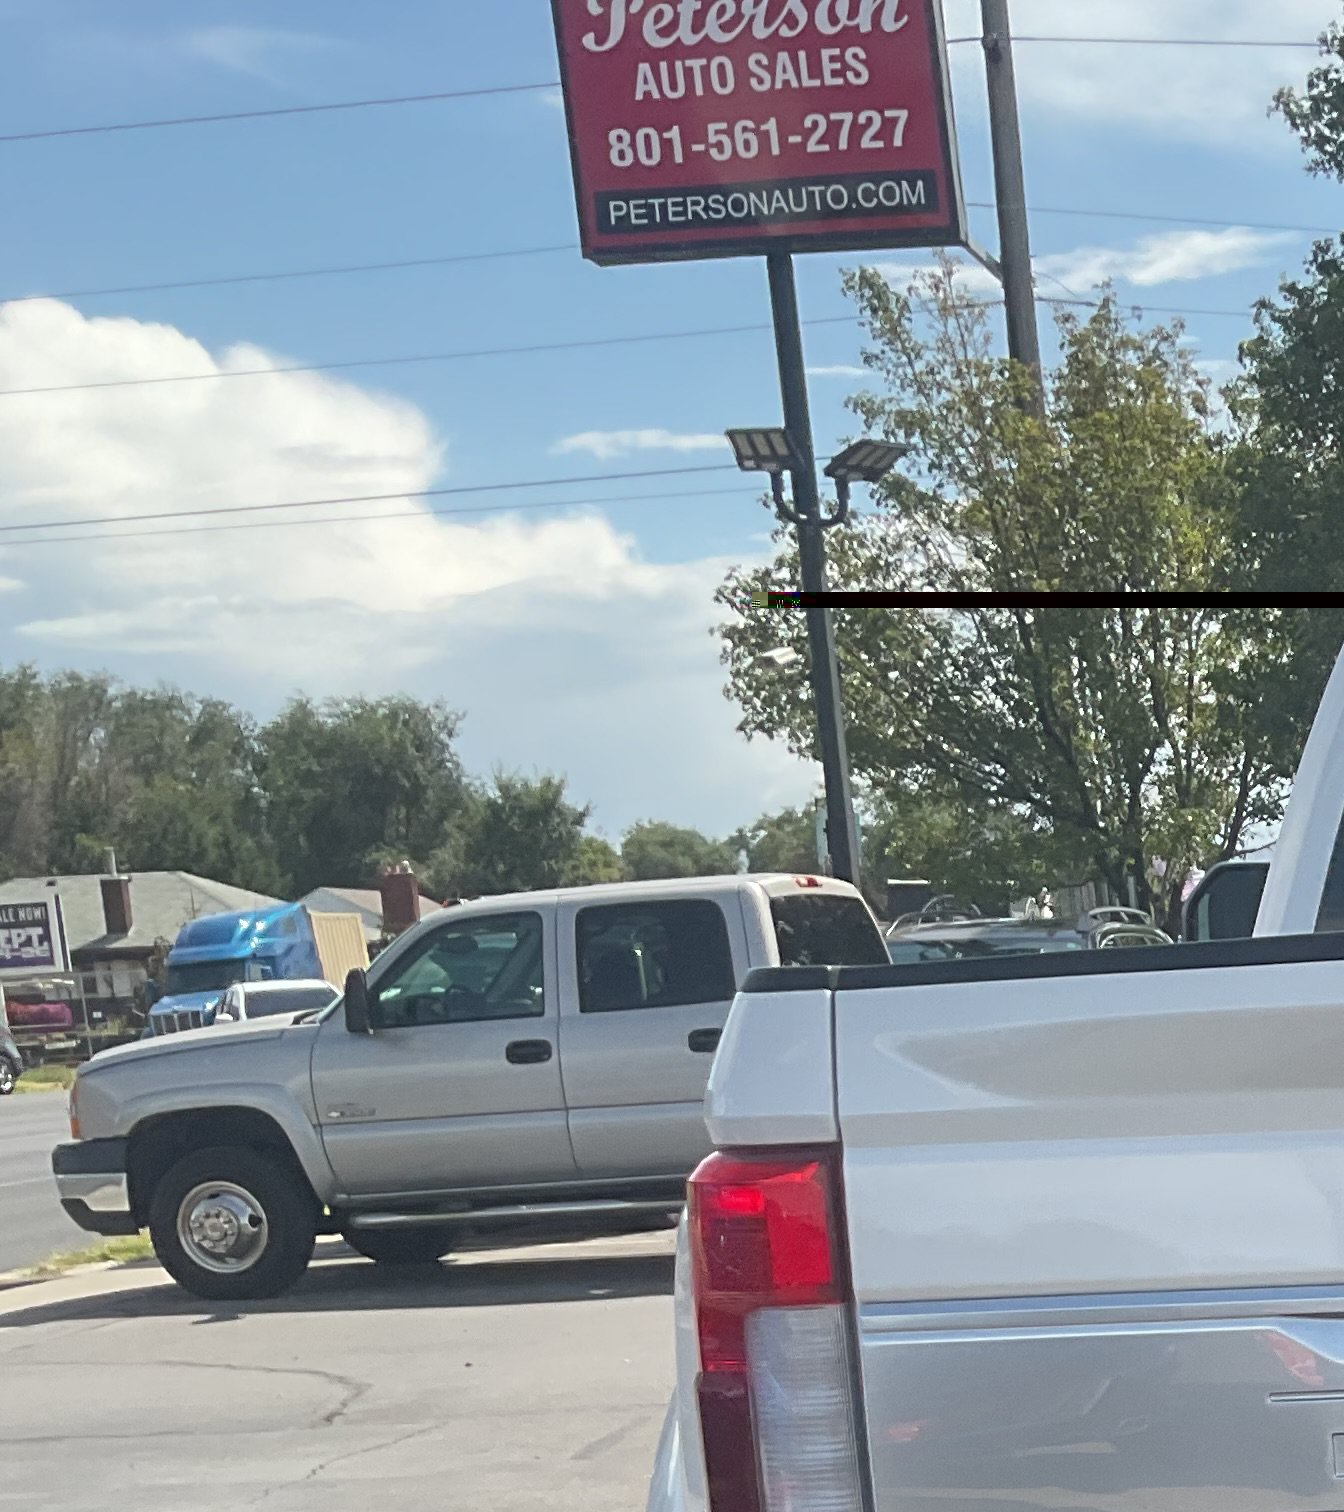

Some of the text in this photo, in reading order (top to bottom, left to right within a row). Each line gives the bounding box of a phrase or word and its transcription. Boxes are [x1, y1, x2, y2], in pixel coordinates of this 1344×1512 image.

[582, 0, 908, 52] Peterson
[635, 47, 870, 101] AUTO SALES
[608, 109, 910, 167] 801-561-2727
[609, 180, 925, 226] PETERSONAUTO.COM
